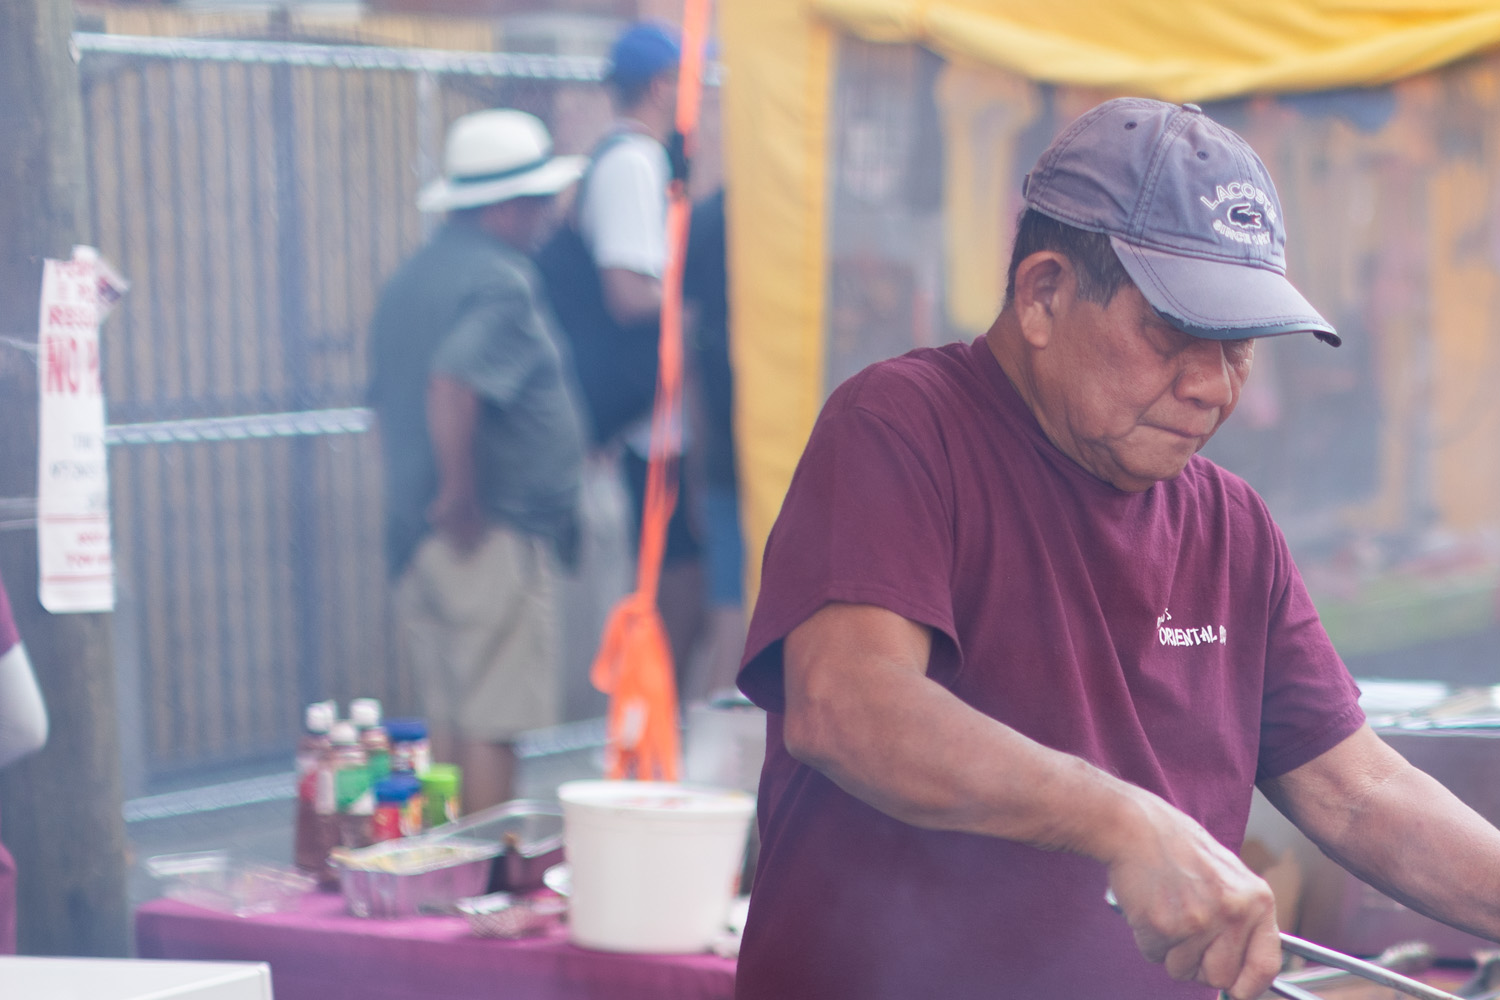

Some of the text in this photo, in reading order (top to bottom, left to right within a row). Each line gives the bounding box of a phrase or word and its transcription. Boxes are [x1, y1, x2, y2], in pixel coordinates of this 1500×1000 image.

[1200, 181, 1277, 224] LACOSTE
[1212, 219, 1252, 244] SINCE
[1158, 625, 1218, 647] ORIENTAL
